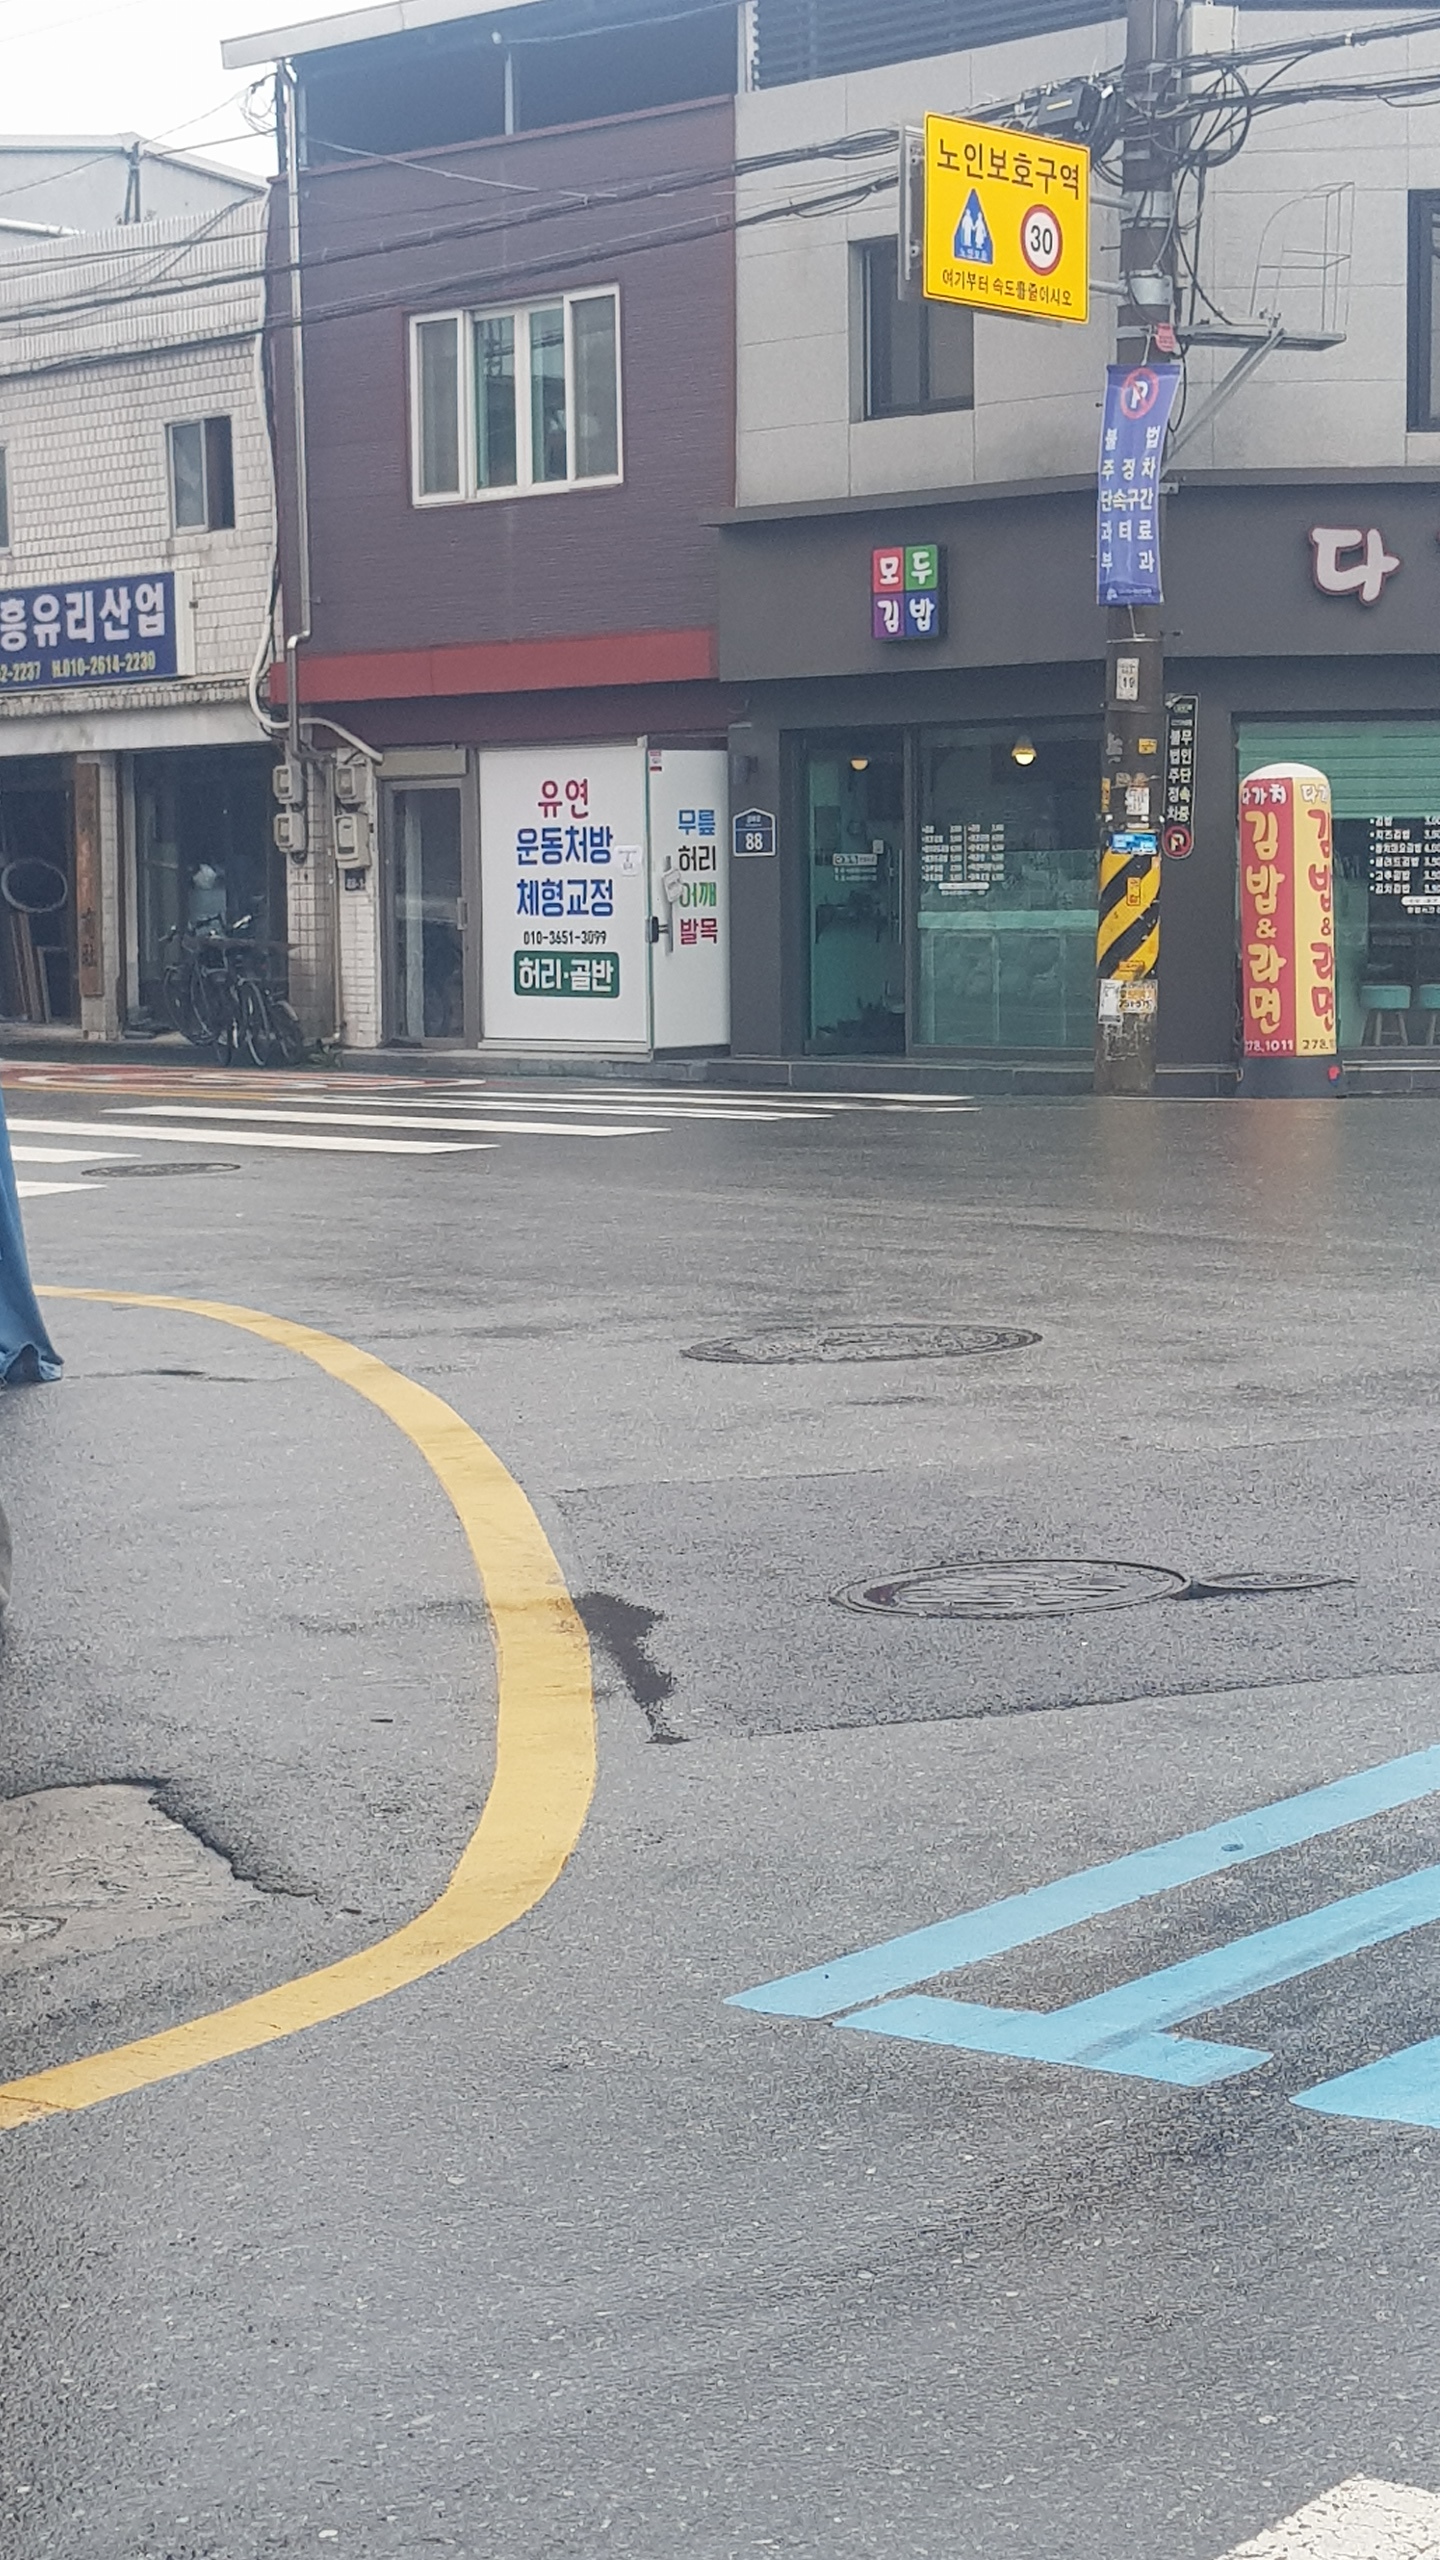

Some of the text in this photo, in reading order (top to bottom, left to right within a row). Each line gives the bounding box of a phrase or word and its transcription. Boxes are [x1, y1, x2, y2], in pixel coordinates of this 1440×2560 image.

[937, 138, 1079, 200] 노인보호구역
[1030, 225, 1053, 255] 30
[942, 268, 988, 294] 여기부터
[1101, 487, 1153, 512] 단속구간
[879, 551, 933, 585] 모두
[1311, 527, 1401, 602] 다
[1, 582, 165, 652] 흥유리산업
[877, 597, 935, 633] 김밥
[538, 778, 589, 819] 유연
[678, 809, 716, 836] 무릎
[516, 826, 613, 866] 운동처방
[745, 832, 763, 850] 88
[678, 845, 717, 871] 허리
[516, 877, 614, 917] 체형교정
[679, 881, 717, 907] 어깨
[680, 917, 718, 945] 발목
